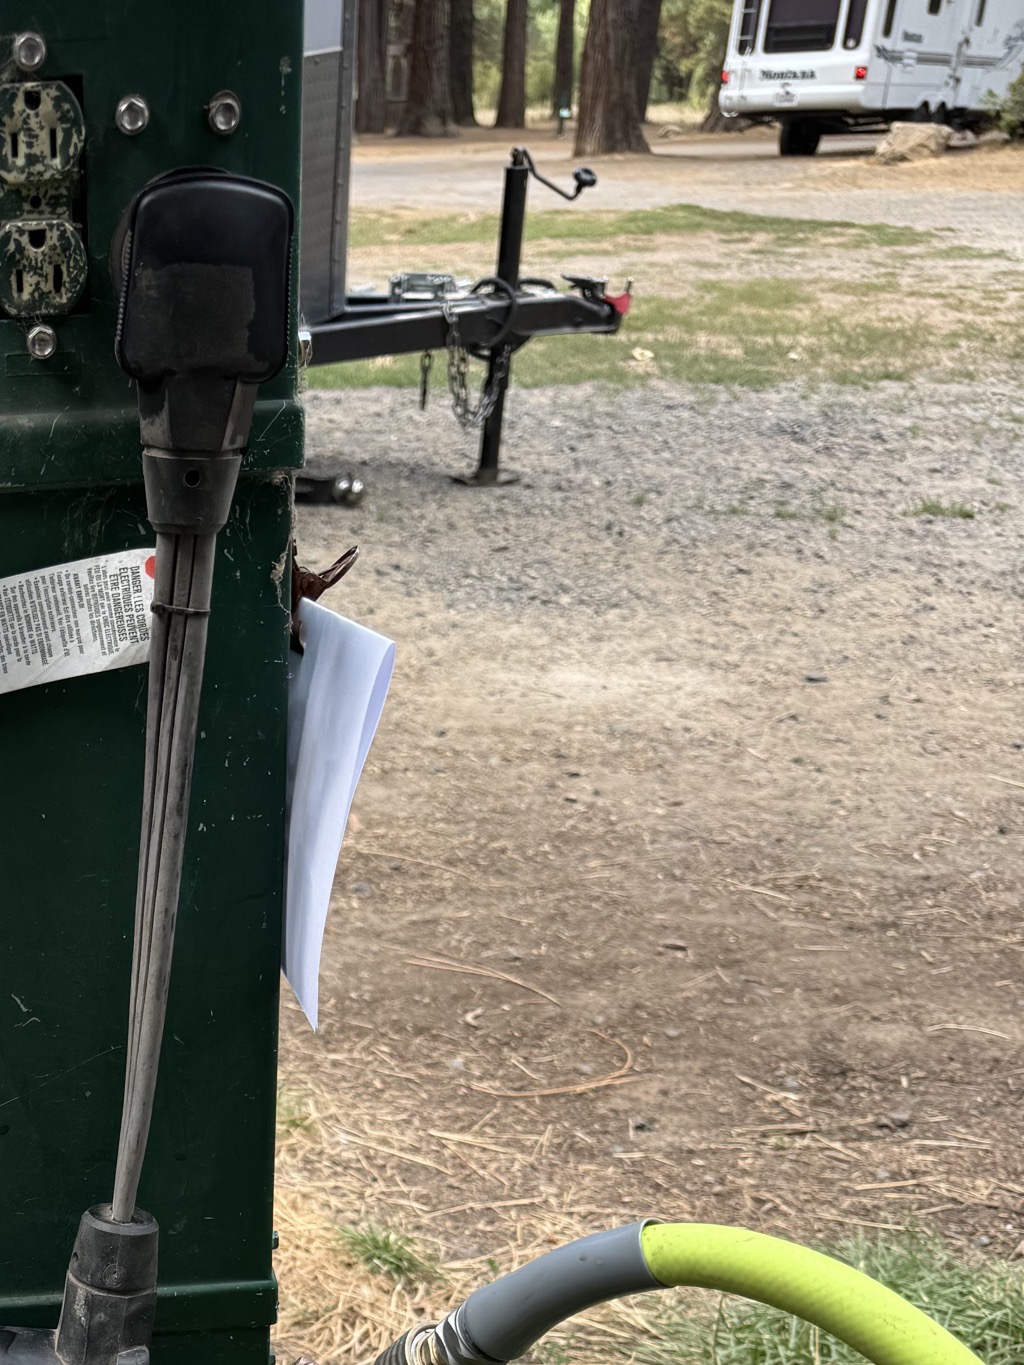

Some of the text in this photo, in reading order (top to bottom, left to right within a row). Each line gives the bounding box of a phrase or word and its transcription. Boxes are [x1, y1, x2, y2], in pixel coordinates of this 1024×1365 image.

[129, 565, 142, 594] DANGER
[111, 592, 127, 641] DANGEREUSES
[133, 599, 144, 612] LES
[125, 613, 139, 643] PEUVENT
[135, 613, 149, 641] CORDES
